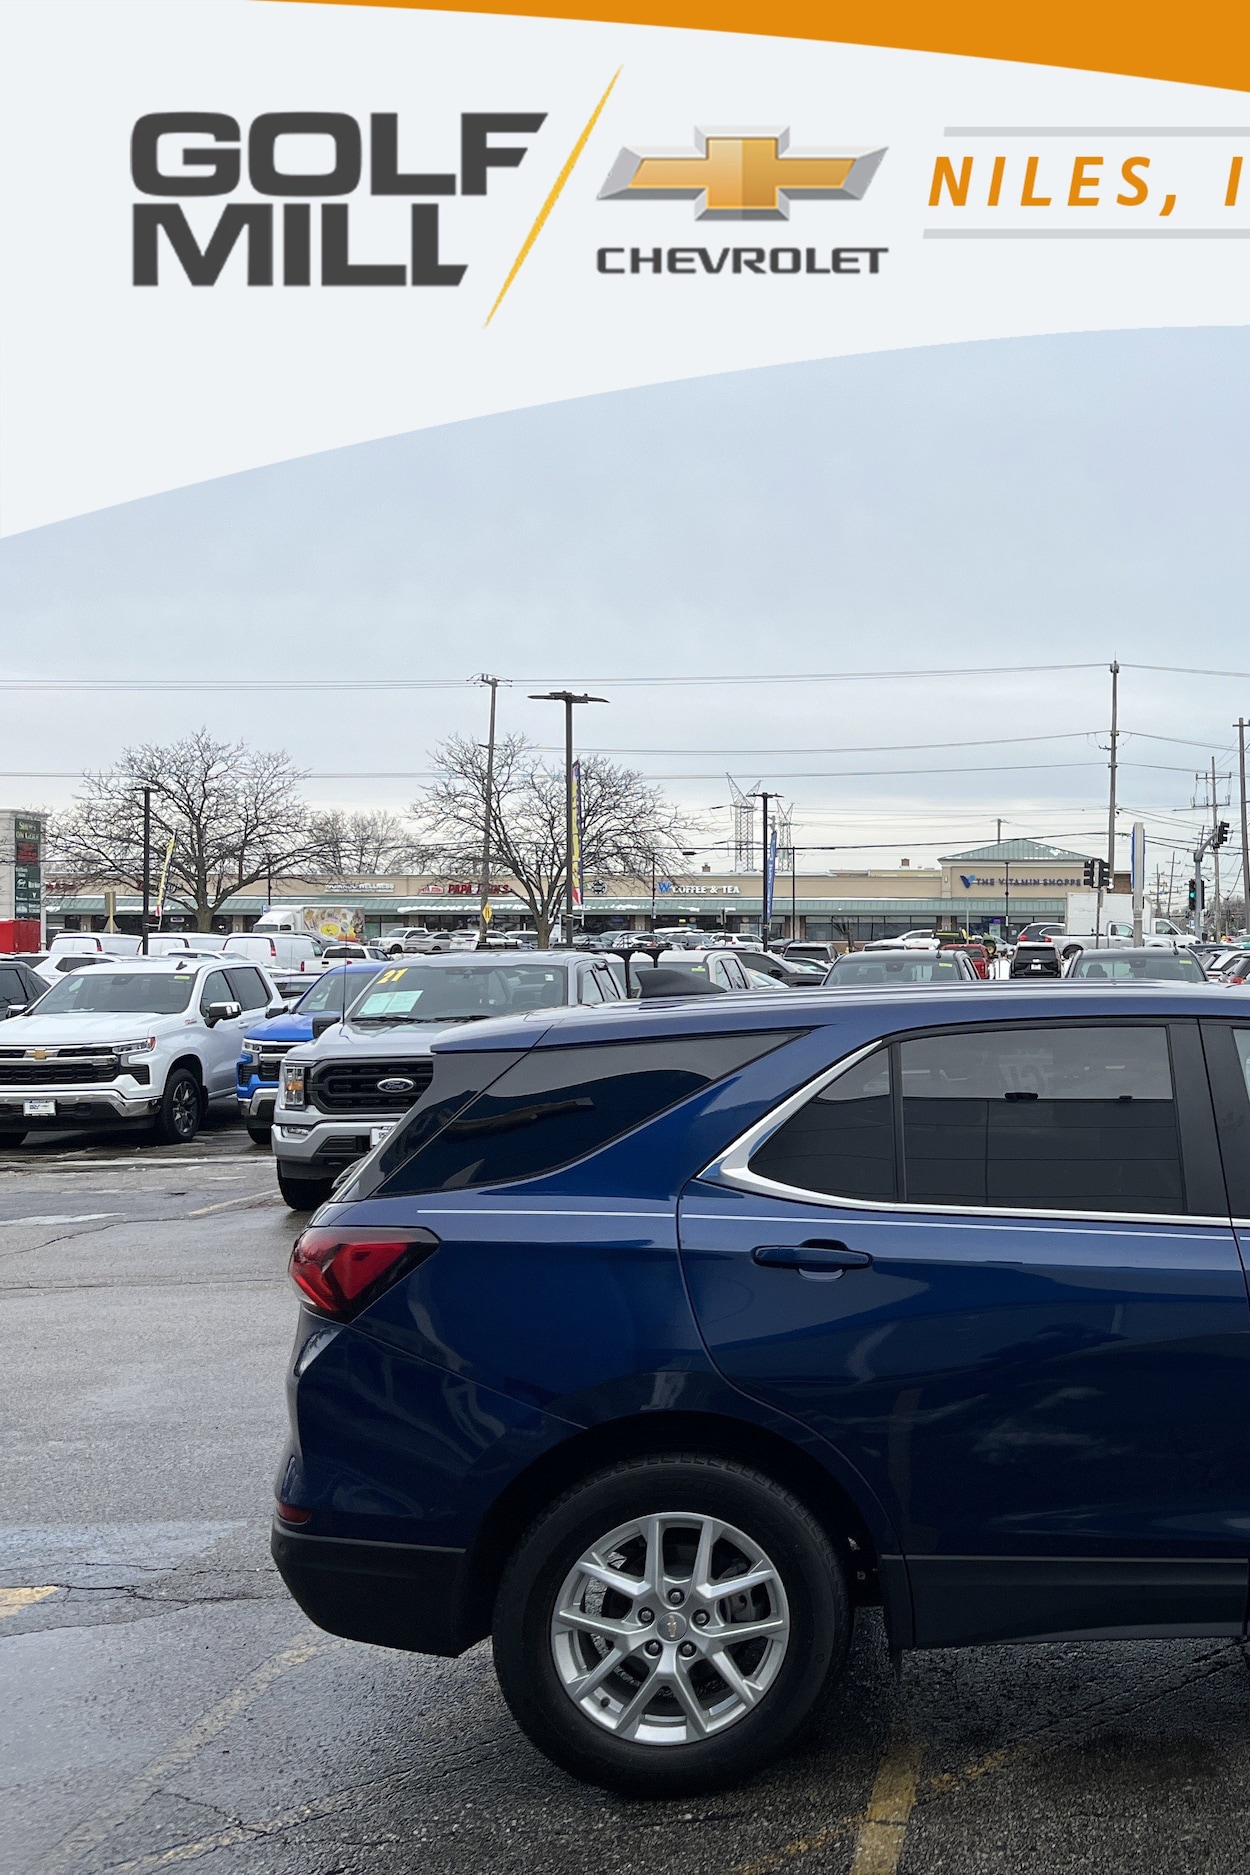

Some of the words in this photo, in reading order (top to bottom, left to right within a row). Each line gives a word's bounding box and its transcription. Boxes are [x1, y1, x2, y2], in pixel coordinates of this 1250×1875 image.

[976, 878, 995, 886] THE
[999, 878, 1039, 886] VTAMIN
[1043, 878, 1082, 887] SHOPPE
[448, 884, 473, 894] PAPA
[672, 885, 707, 894] COFFEE
[709, 885, 718, 894] &
[721, 885, 740, 894] TEA
[376, 967, 409, 985] 21
